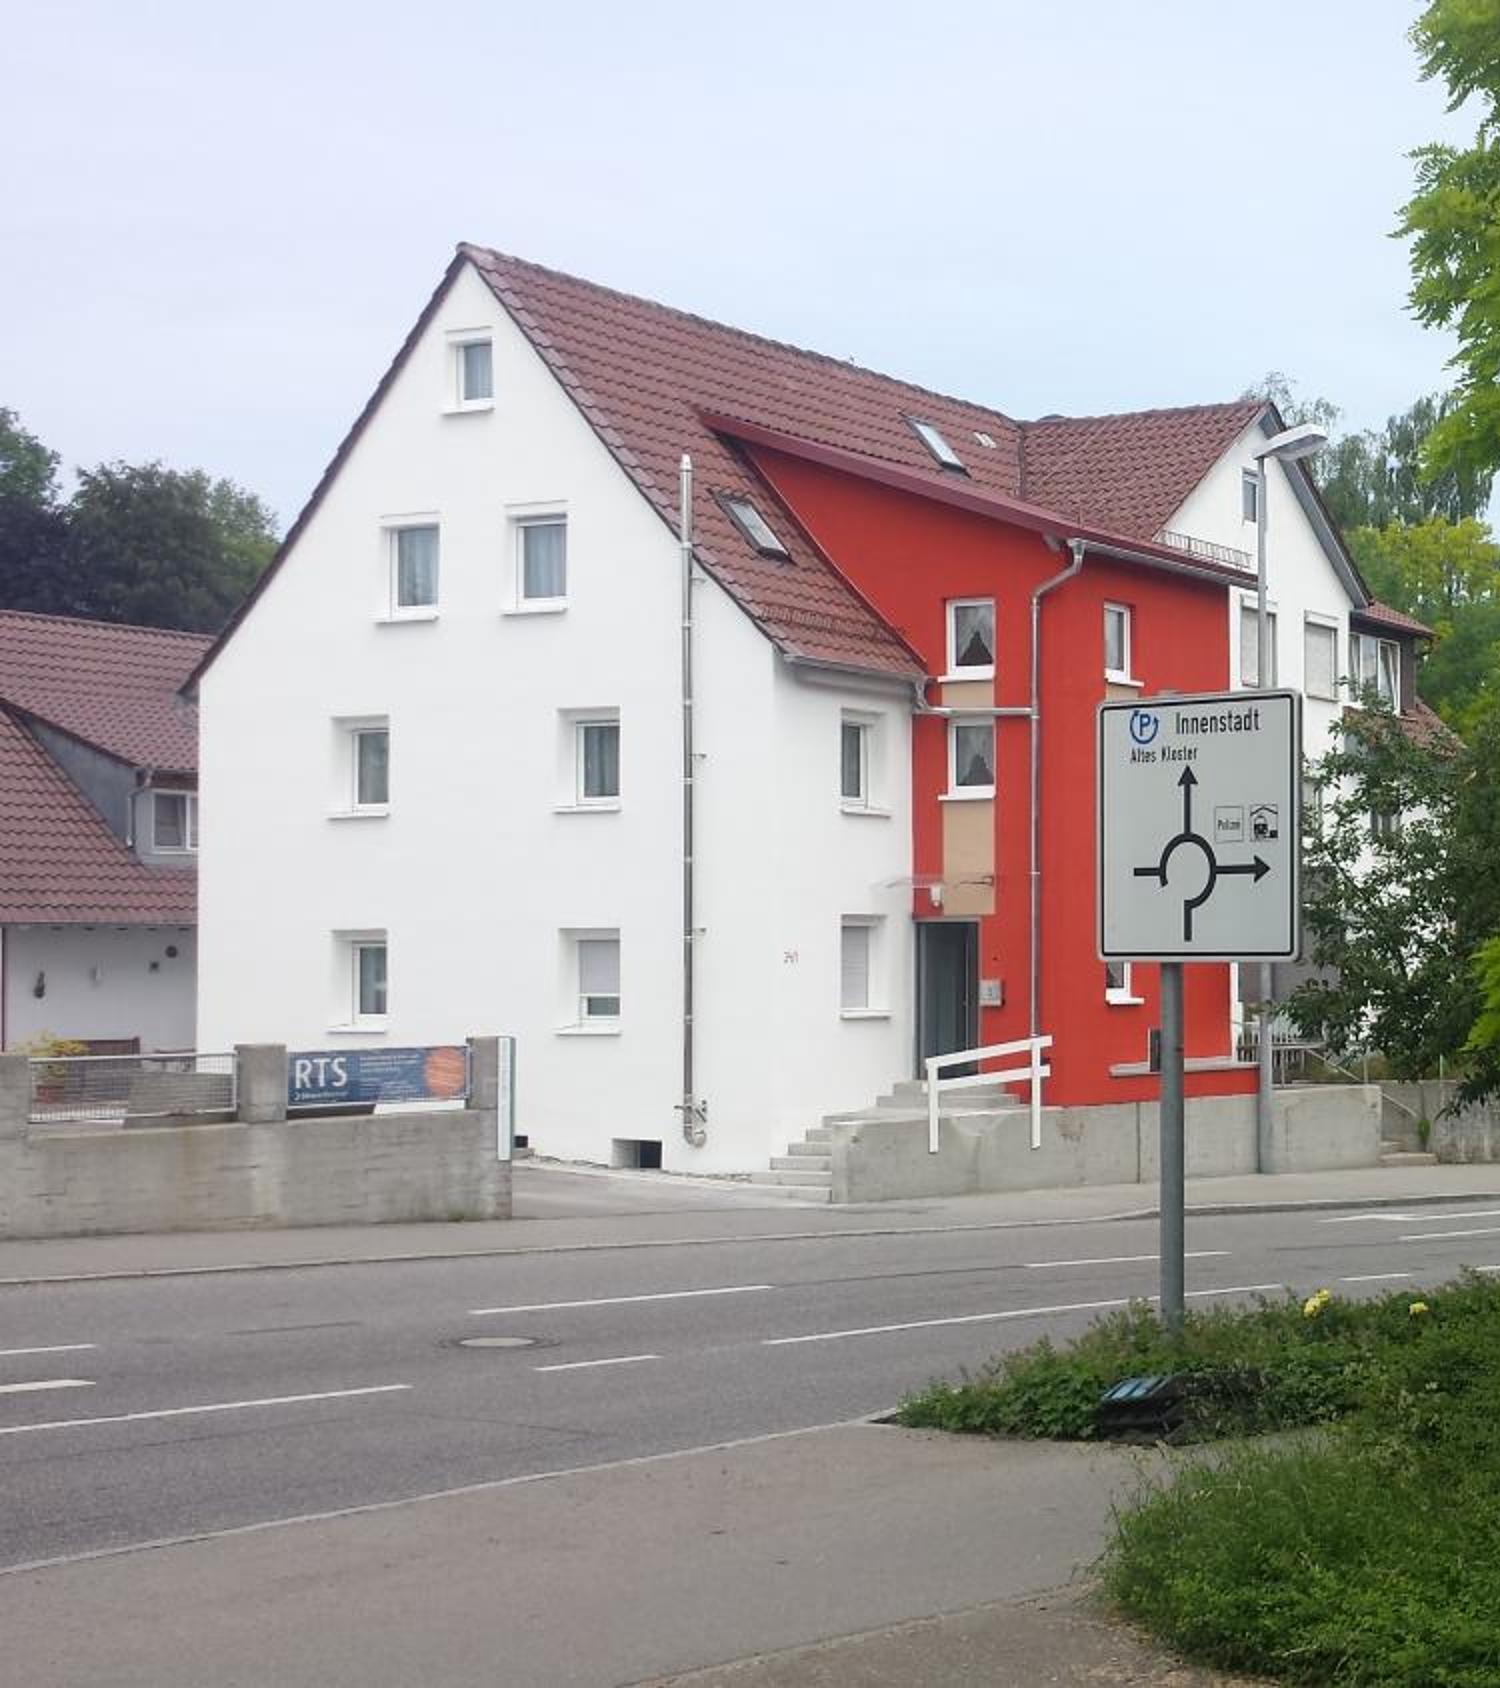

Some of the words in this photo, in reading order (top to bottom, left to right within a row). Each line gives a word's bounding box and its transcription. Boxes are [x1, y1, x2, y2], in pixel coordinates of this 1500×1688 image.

[1175, 708, 1260, 734] Innenstadt
[1130, 747, 1157, 763] Altes
[1161, 745, 1198, 761] Kloster
[295, 1057, 348, 1089] RTS
